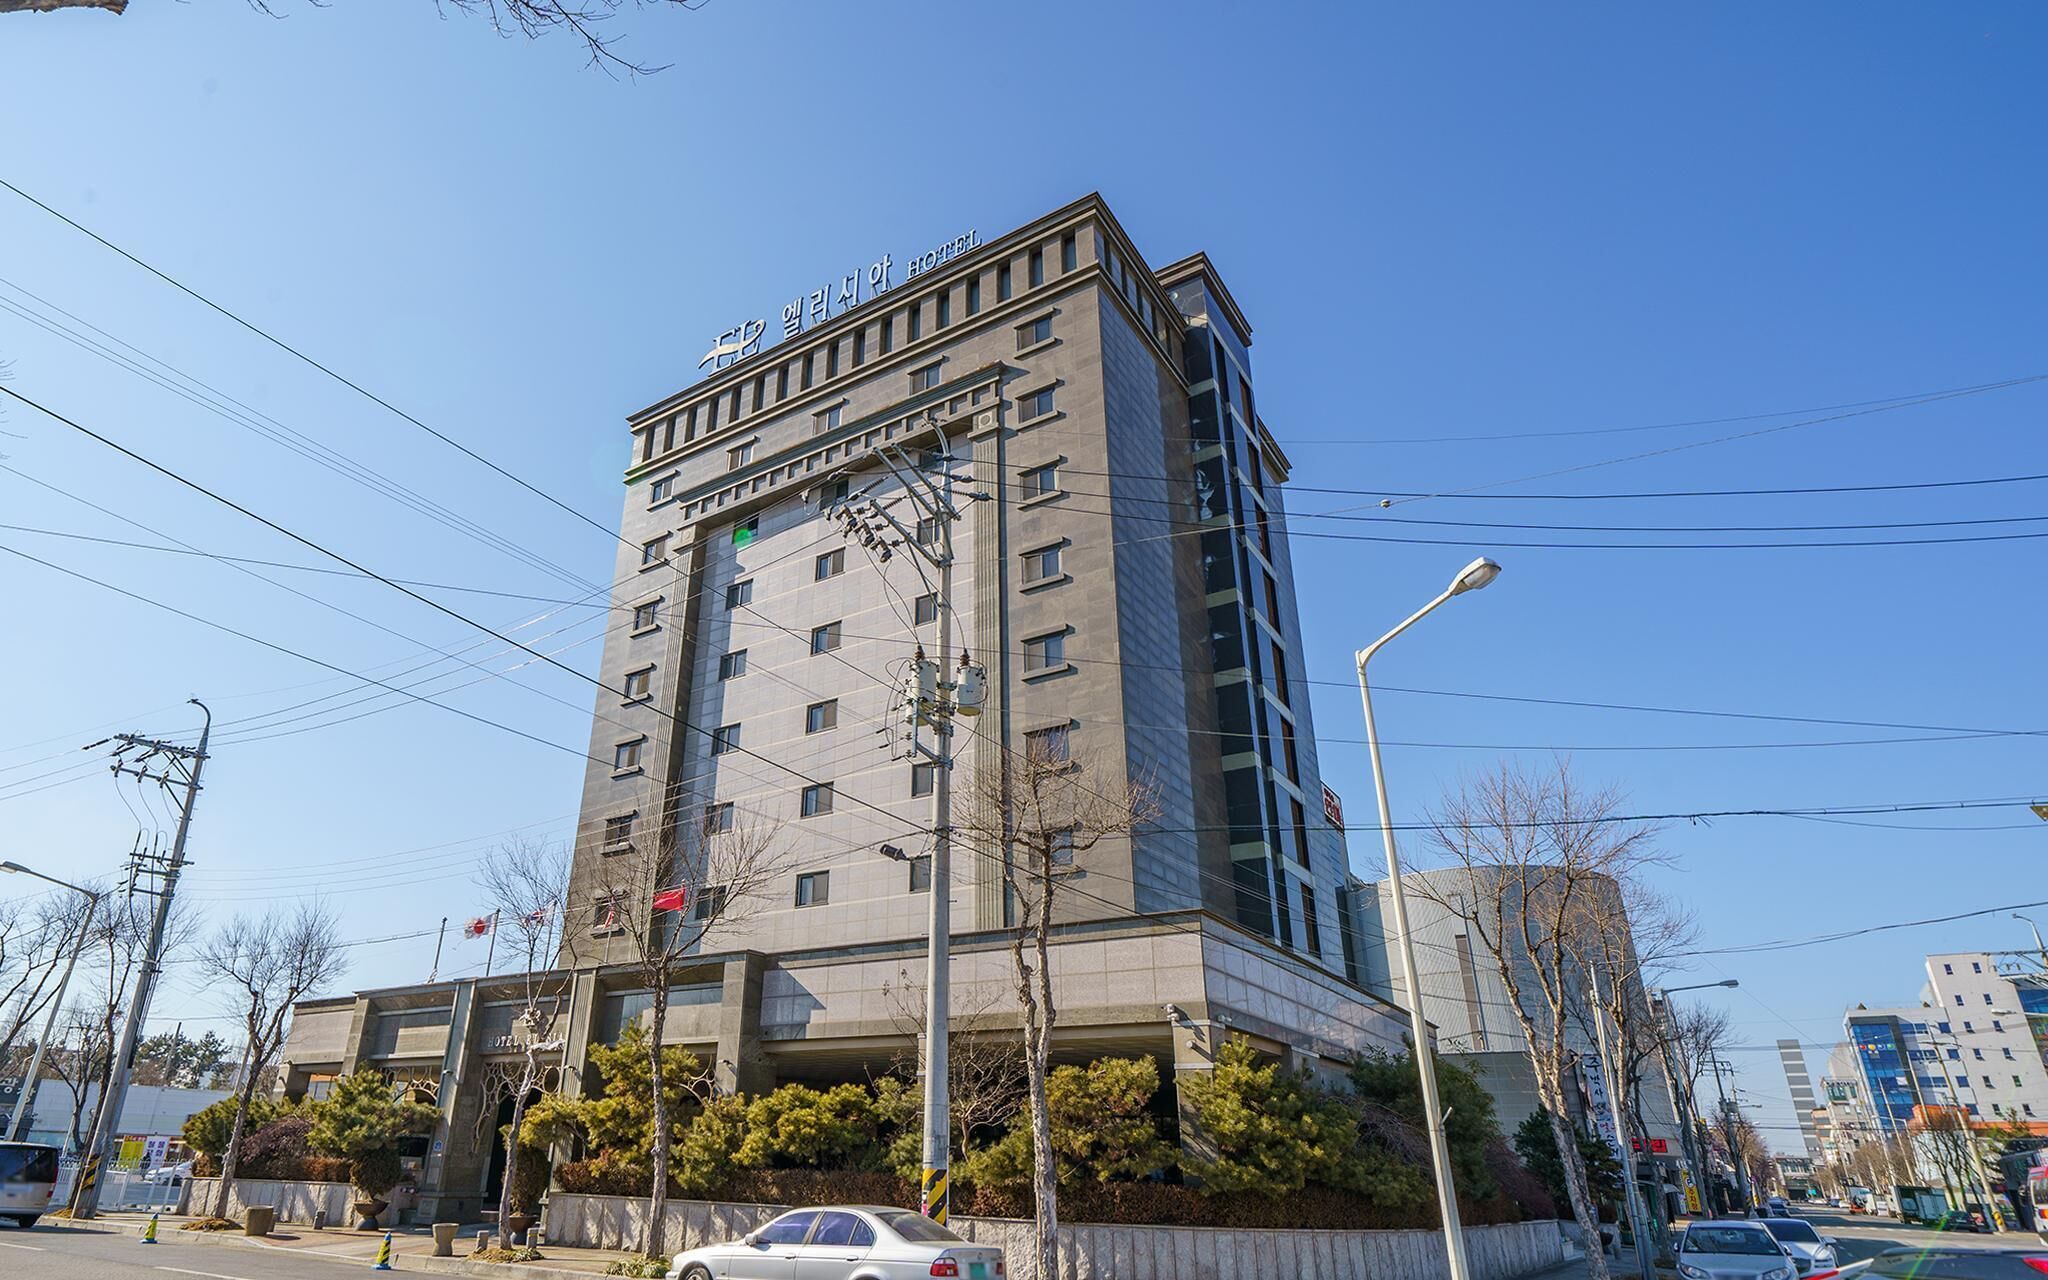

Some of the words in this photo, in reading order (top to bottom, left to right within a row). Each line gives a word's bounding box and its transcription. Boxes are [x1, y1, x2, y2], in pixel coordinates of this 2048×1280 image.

[782, 253, 893, 341] 엘리시아
[906, 229, 982, 281] HOTEL
[487, 1035, 520, 1047] HOTEL
[526, 1032, 565, 1046] ELSIA
